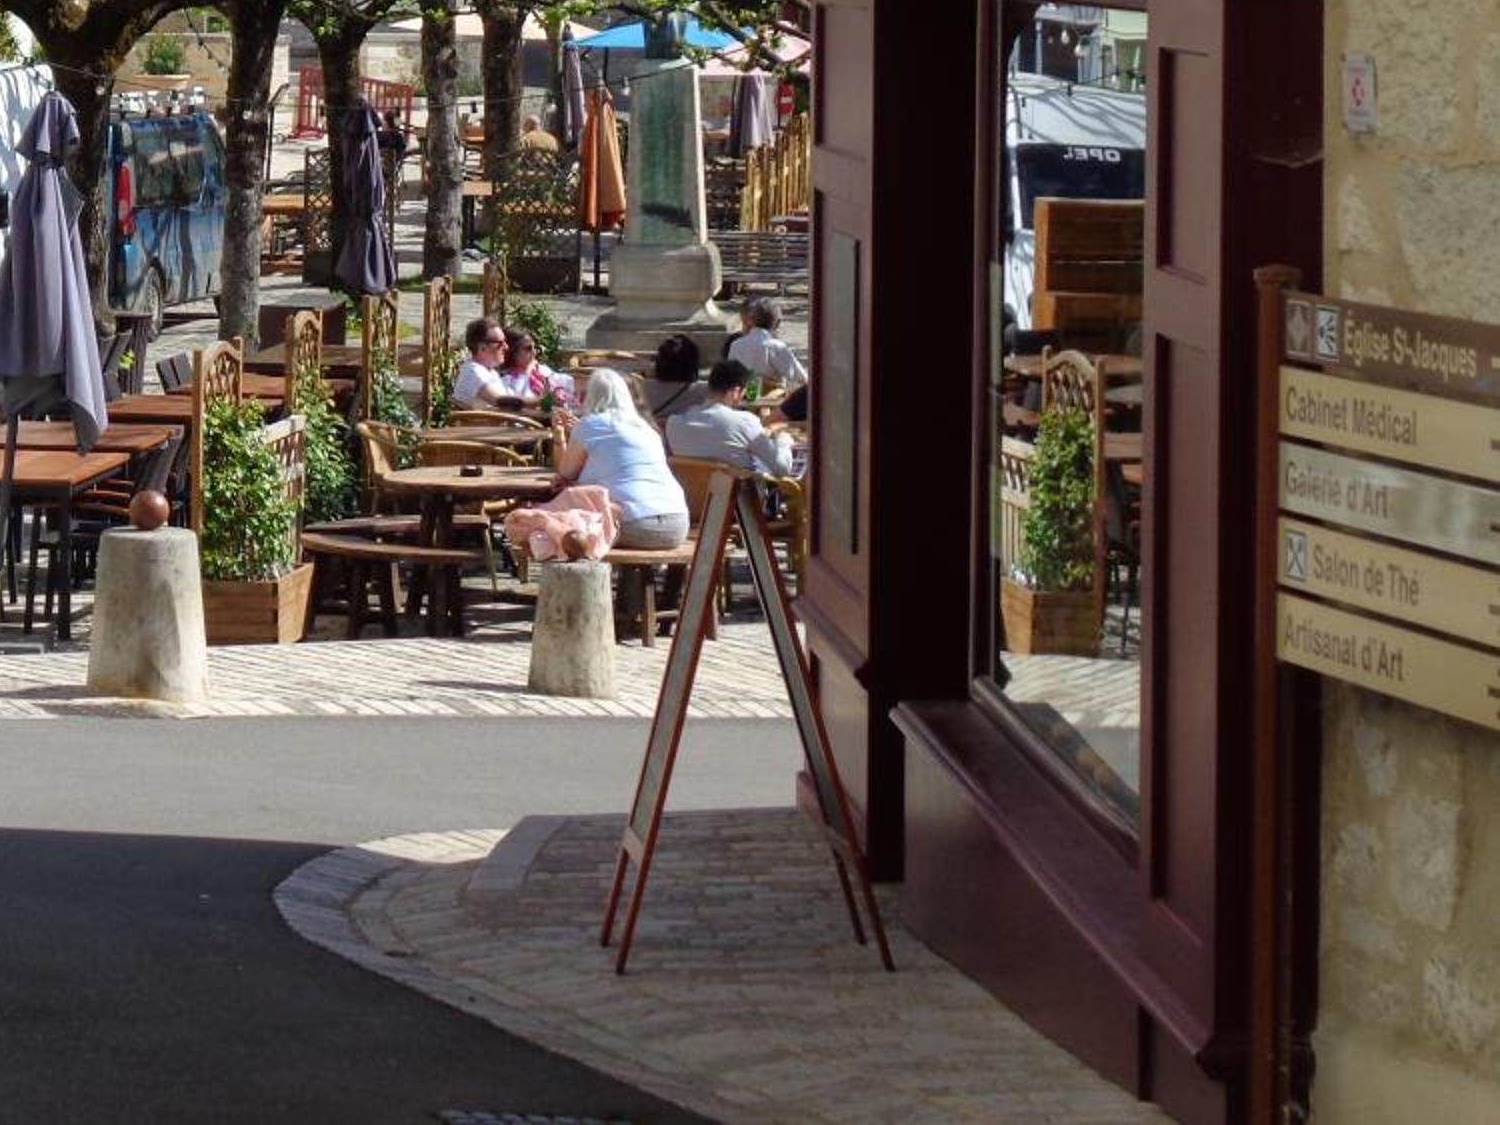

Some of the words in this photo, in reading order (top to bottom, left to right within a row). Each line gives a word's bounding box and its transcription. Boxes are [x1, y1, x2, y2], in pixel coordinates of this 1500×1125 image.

[1344, 309, 1390, 366] Église
[1285, 385, 1348, 431] Cabinet
[1352, 396, 1418, 445] Médical
[1284, 461, 1342, 508] Galerie
[1347, 476, 1388, 519] d'Art
[1314, 544, 1359, 588] Salon
[1364, 559, 1384, 596] de
[1387, 563, 1419, 607] Thé
[1361, 636, 1404, 682] d'Art
